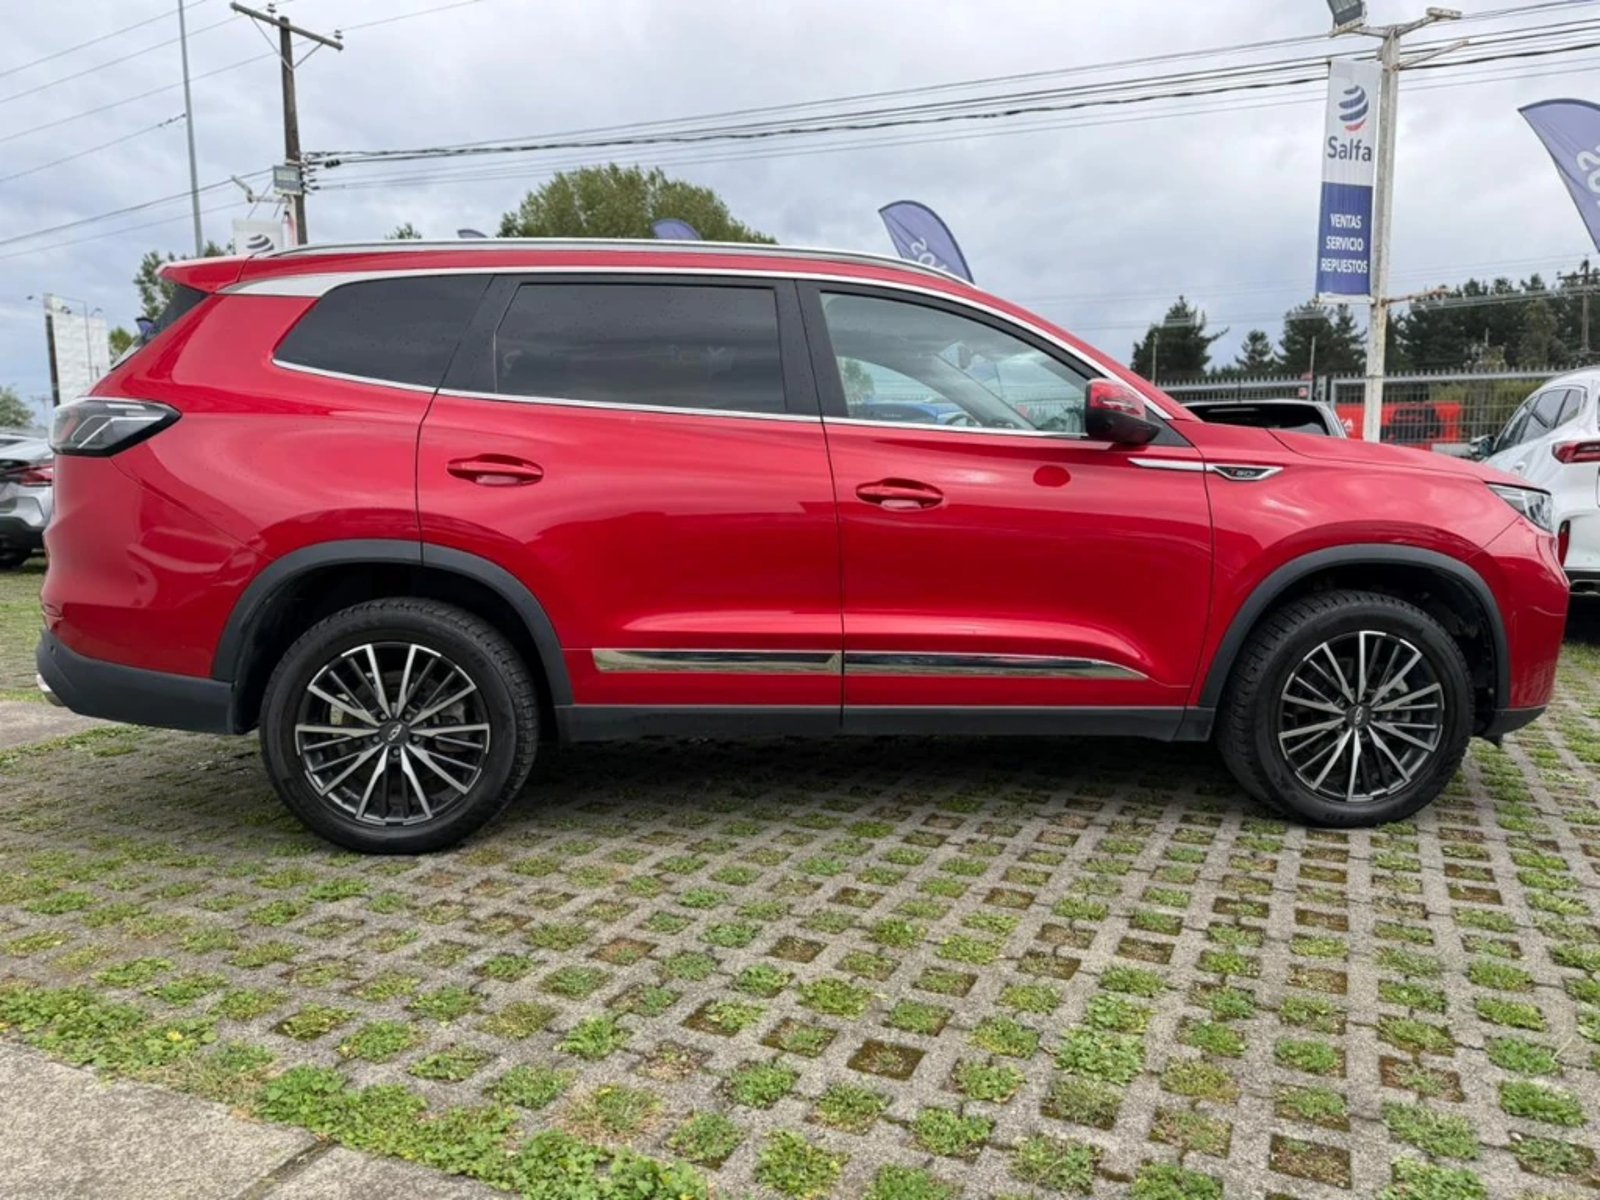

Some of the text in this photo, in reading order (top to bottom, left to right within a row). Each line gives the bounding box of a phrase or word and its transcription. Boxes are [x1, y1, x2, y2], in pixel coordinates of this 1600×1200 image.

[1327, 136, 1372, 161] Salfa
[1330, 213, 1362, 229] VENTAS
[1326, 235, 1364, 251] SERVICIO
[1321, 258, 1368, 274] REPUESTOS
